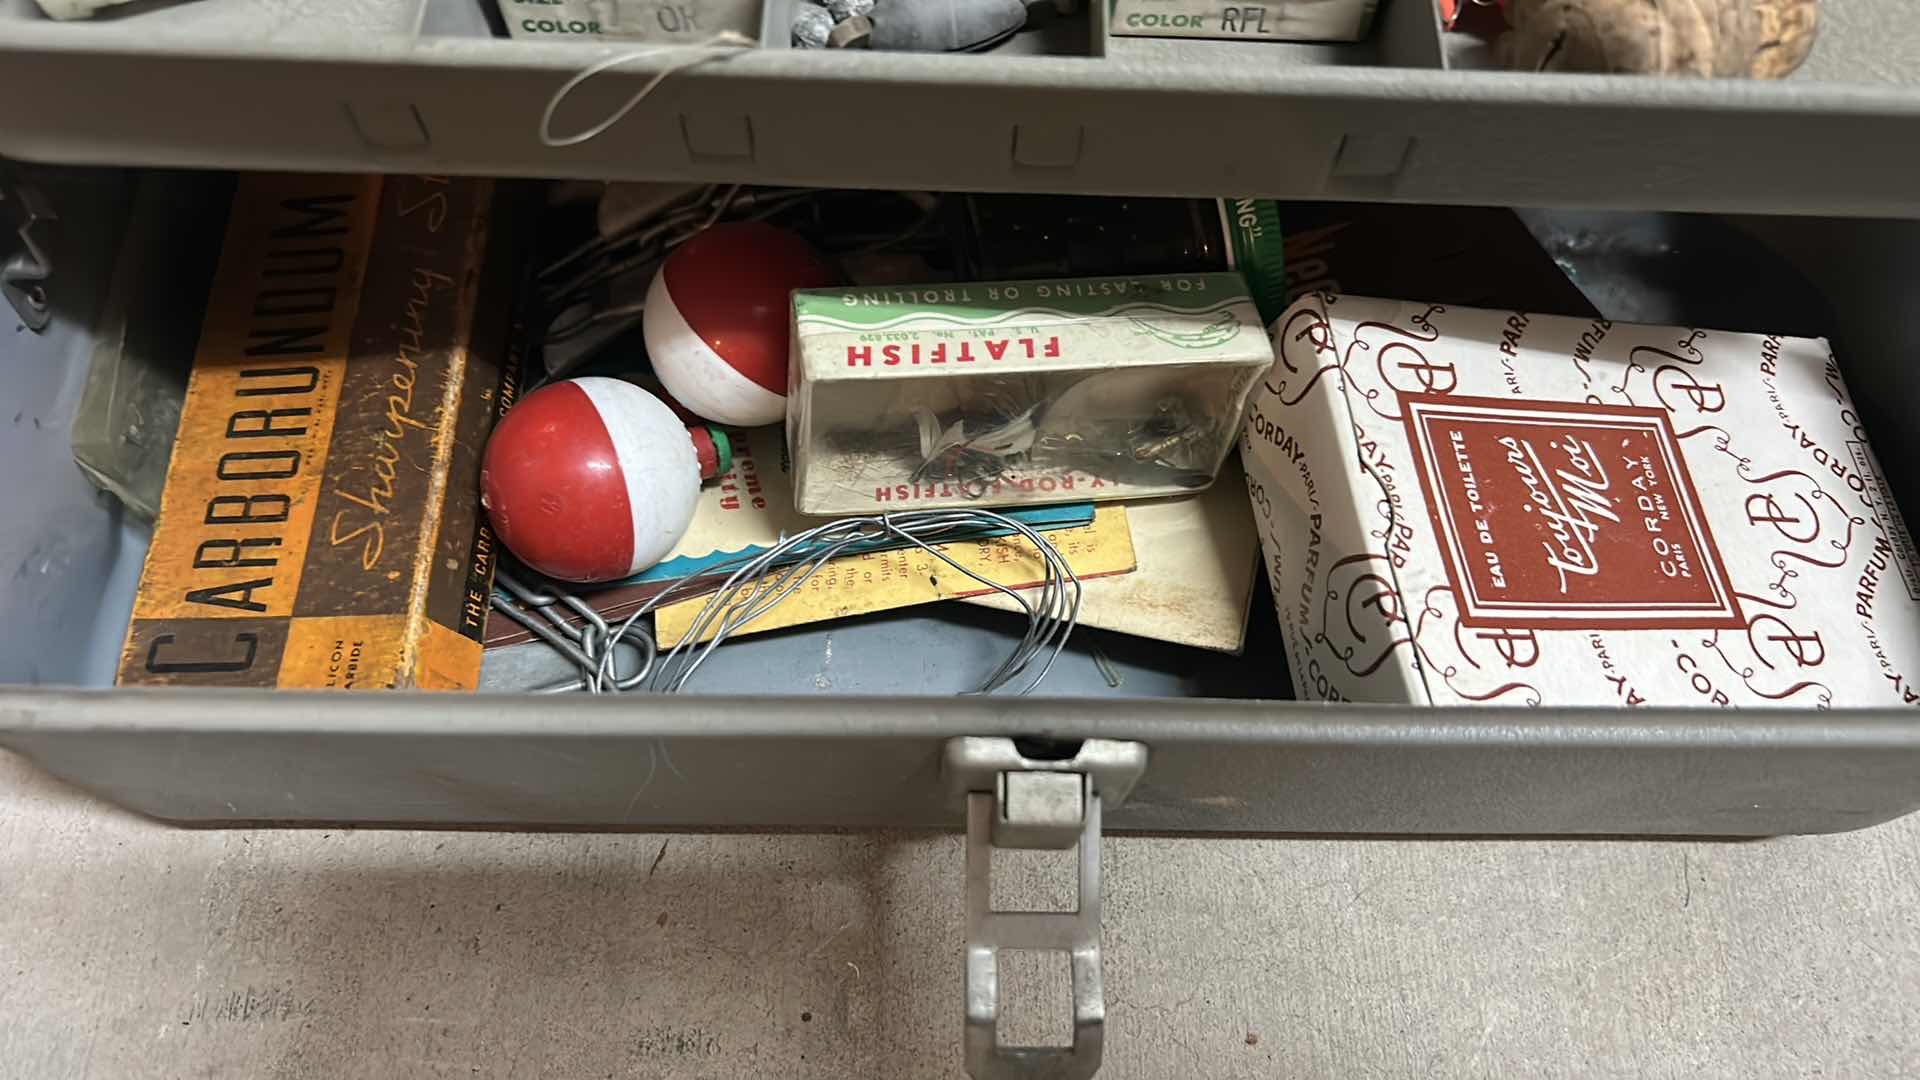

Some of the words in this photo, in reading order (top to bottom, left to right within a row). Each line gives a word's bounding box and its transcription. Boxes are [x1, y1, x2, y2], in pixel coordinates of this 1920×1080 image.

[521, 19, 603, 34] COLOR
[1126, 13, 1203, 28] COLOR
[1221, 7, 1270, 33] RFL
[844, 289, 970, 307] TROLLING
[988, 285, 1020, 300] OR
[847, 336, 1060, 367] FLATFISH
[145, 193, 357, 675] CARBORUNDUM
[1449, 430, 1484, 513] TOILETTE
[1640, 455, 1658, 487] YORK
[1622, 455, 1678, 577] CORDAY
[1653, 493, 1670, 521] NEW
[1475, 519, 1494, 544] DE
[1485, 552, 1507, 588] EAU
[1671, 543, 1692, 578] PARIS
[465, 590, 483, 627] THE
